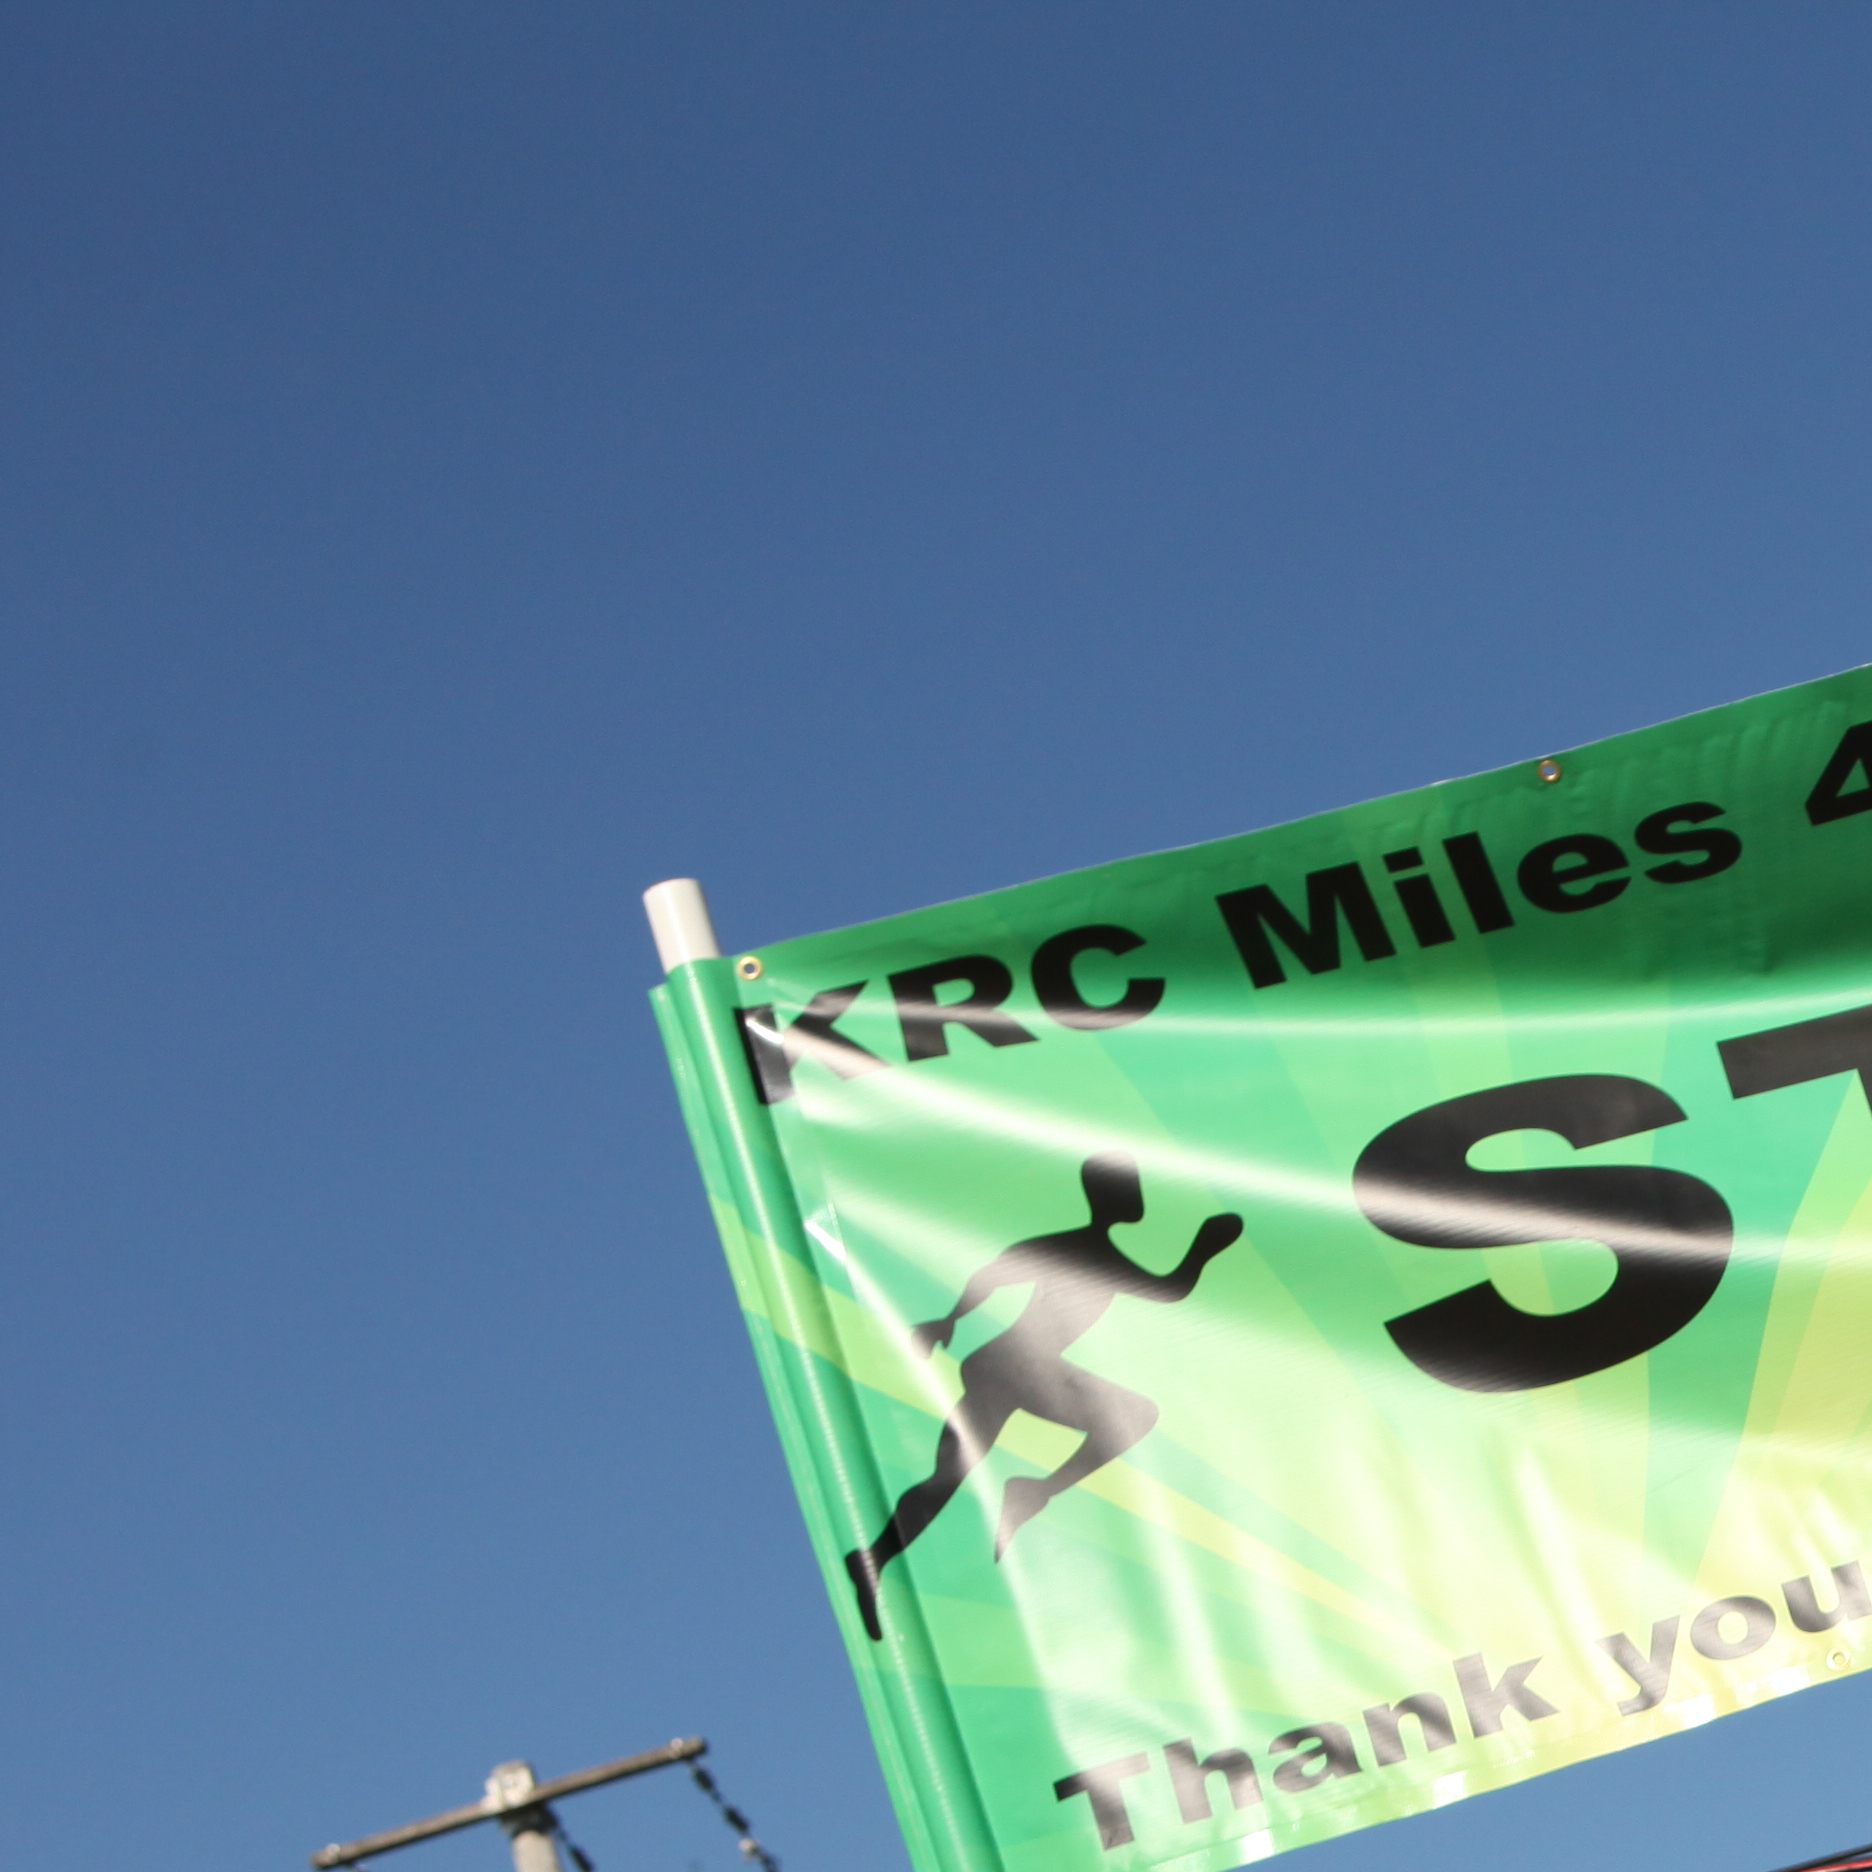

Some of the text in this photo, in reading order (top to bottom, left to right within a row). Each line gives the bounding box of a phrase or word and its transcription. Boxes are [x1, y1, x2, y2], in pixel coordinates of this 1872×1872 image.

[734, 924, 1166, 1105] KRC
[1215, 800, 1743, 990] Miles
[1052, 1650, 1560, 1850] Thank
